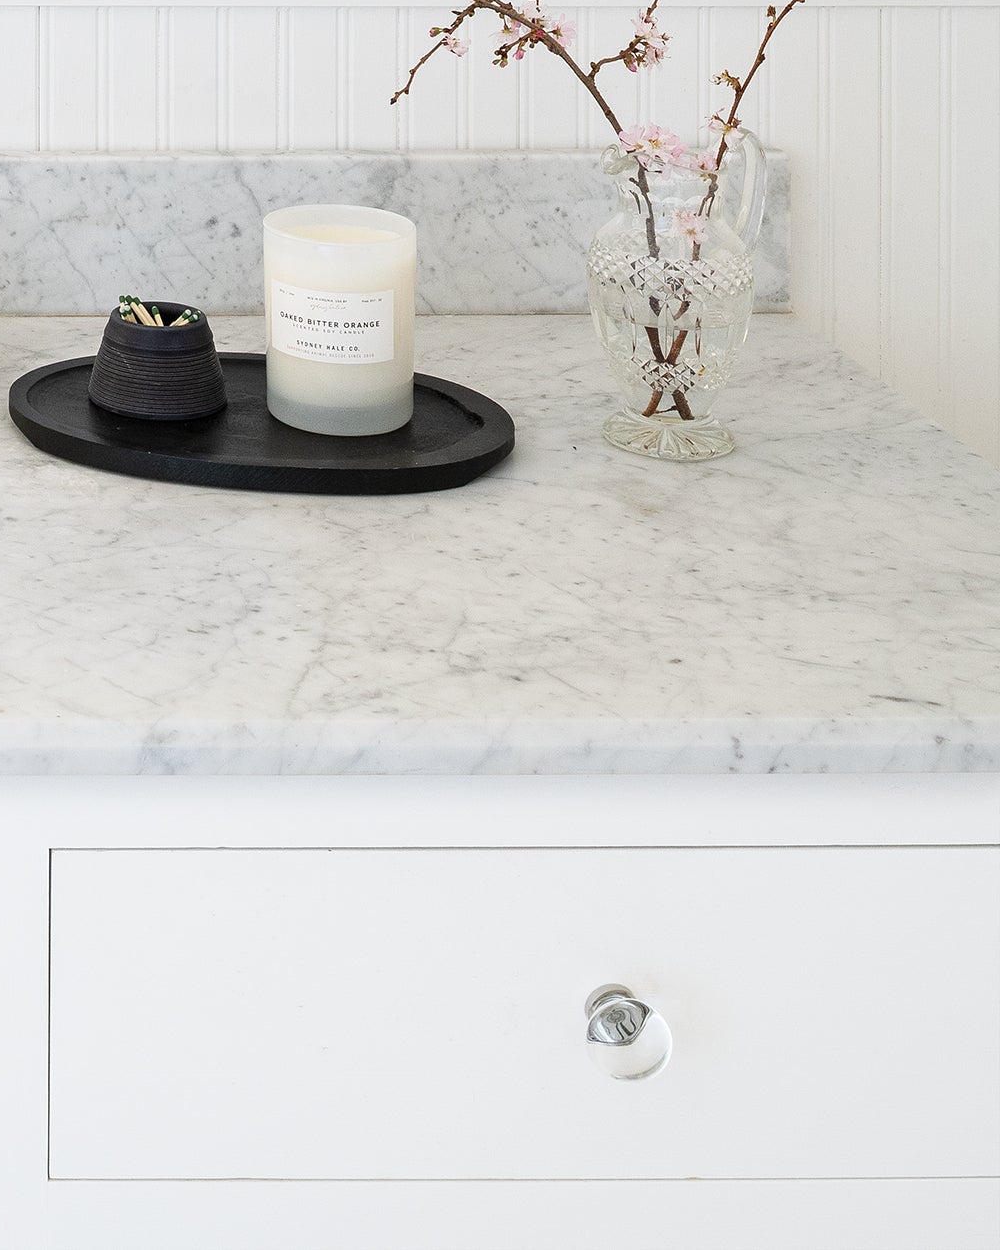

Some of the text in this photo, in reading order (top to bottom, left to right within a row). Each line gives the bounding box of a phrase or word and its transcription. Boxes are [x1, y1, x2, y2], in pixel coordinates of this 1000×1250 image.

[279, 310, 381, 329] OAKED BITTER ORANGE
[292, 323, 319, 332] SCENTED
[296, 339, 322, 350] SYDNEY
